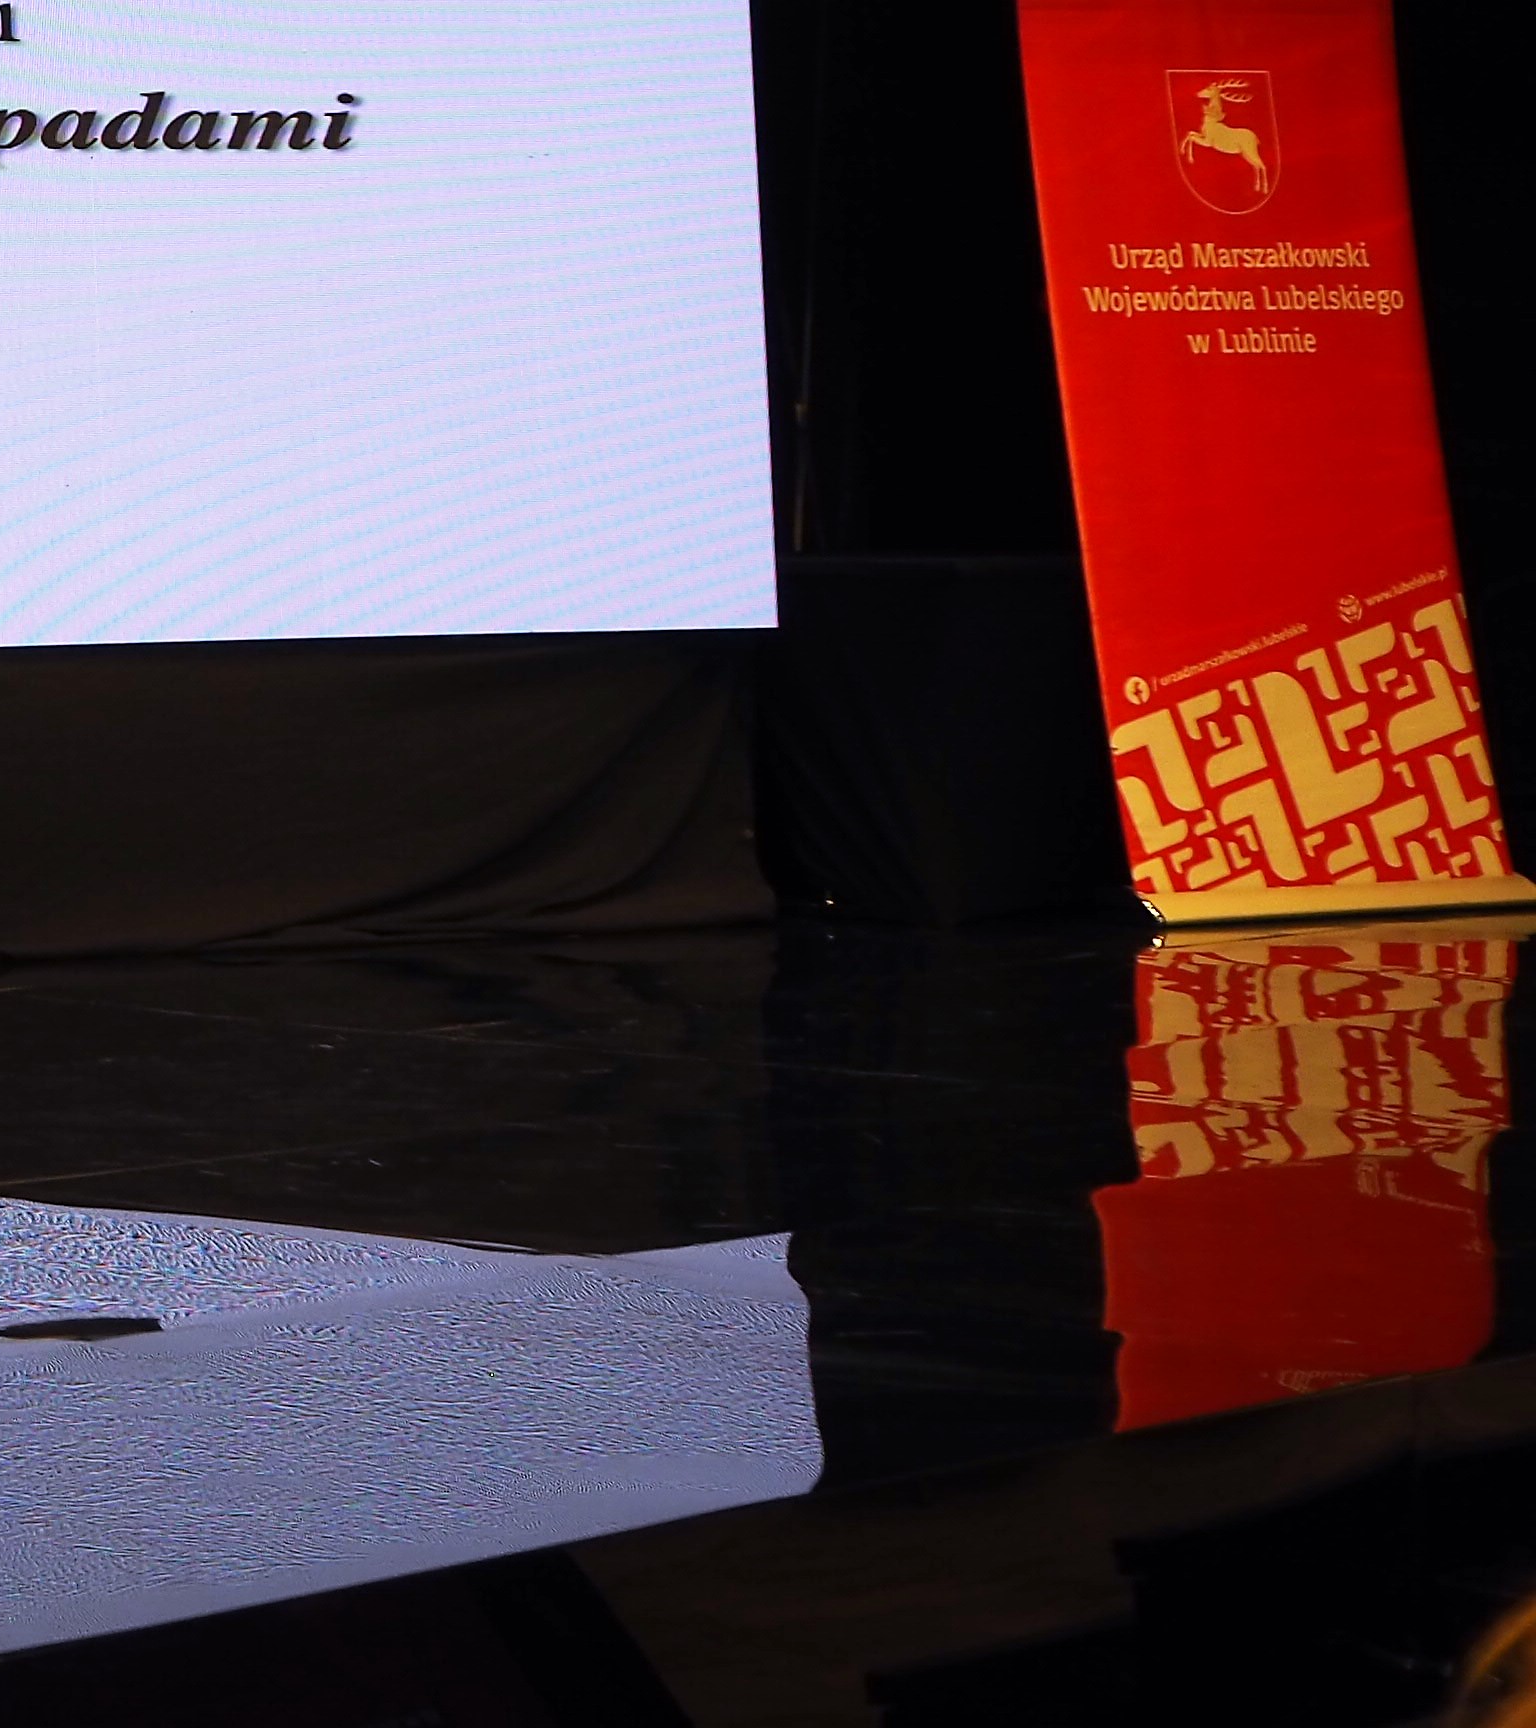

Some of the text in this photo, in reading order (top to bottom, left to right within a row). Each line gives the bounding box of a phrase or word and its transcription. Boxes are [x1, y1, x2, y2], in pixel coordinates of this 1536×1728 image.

[1108, 242, 1370, 274] Urząd Marszałkowski
[1082, 284, 1404, 318] Województwa Lubelskiego
[1186, 326, 1318, 353] w Lublinie
